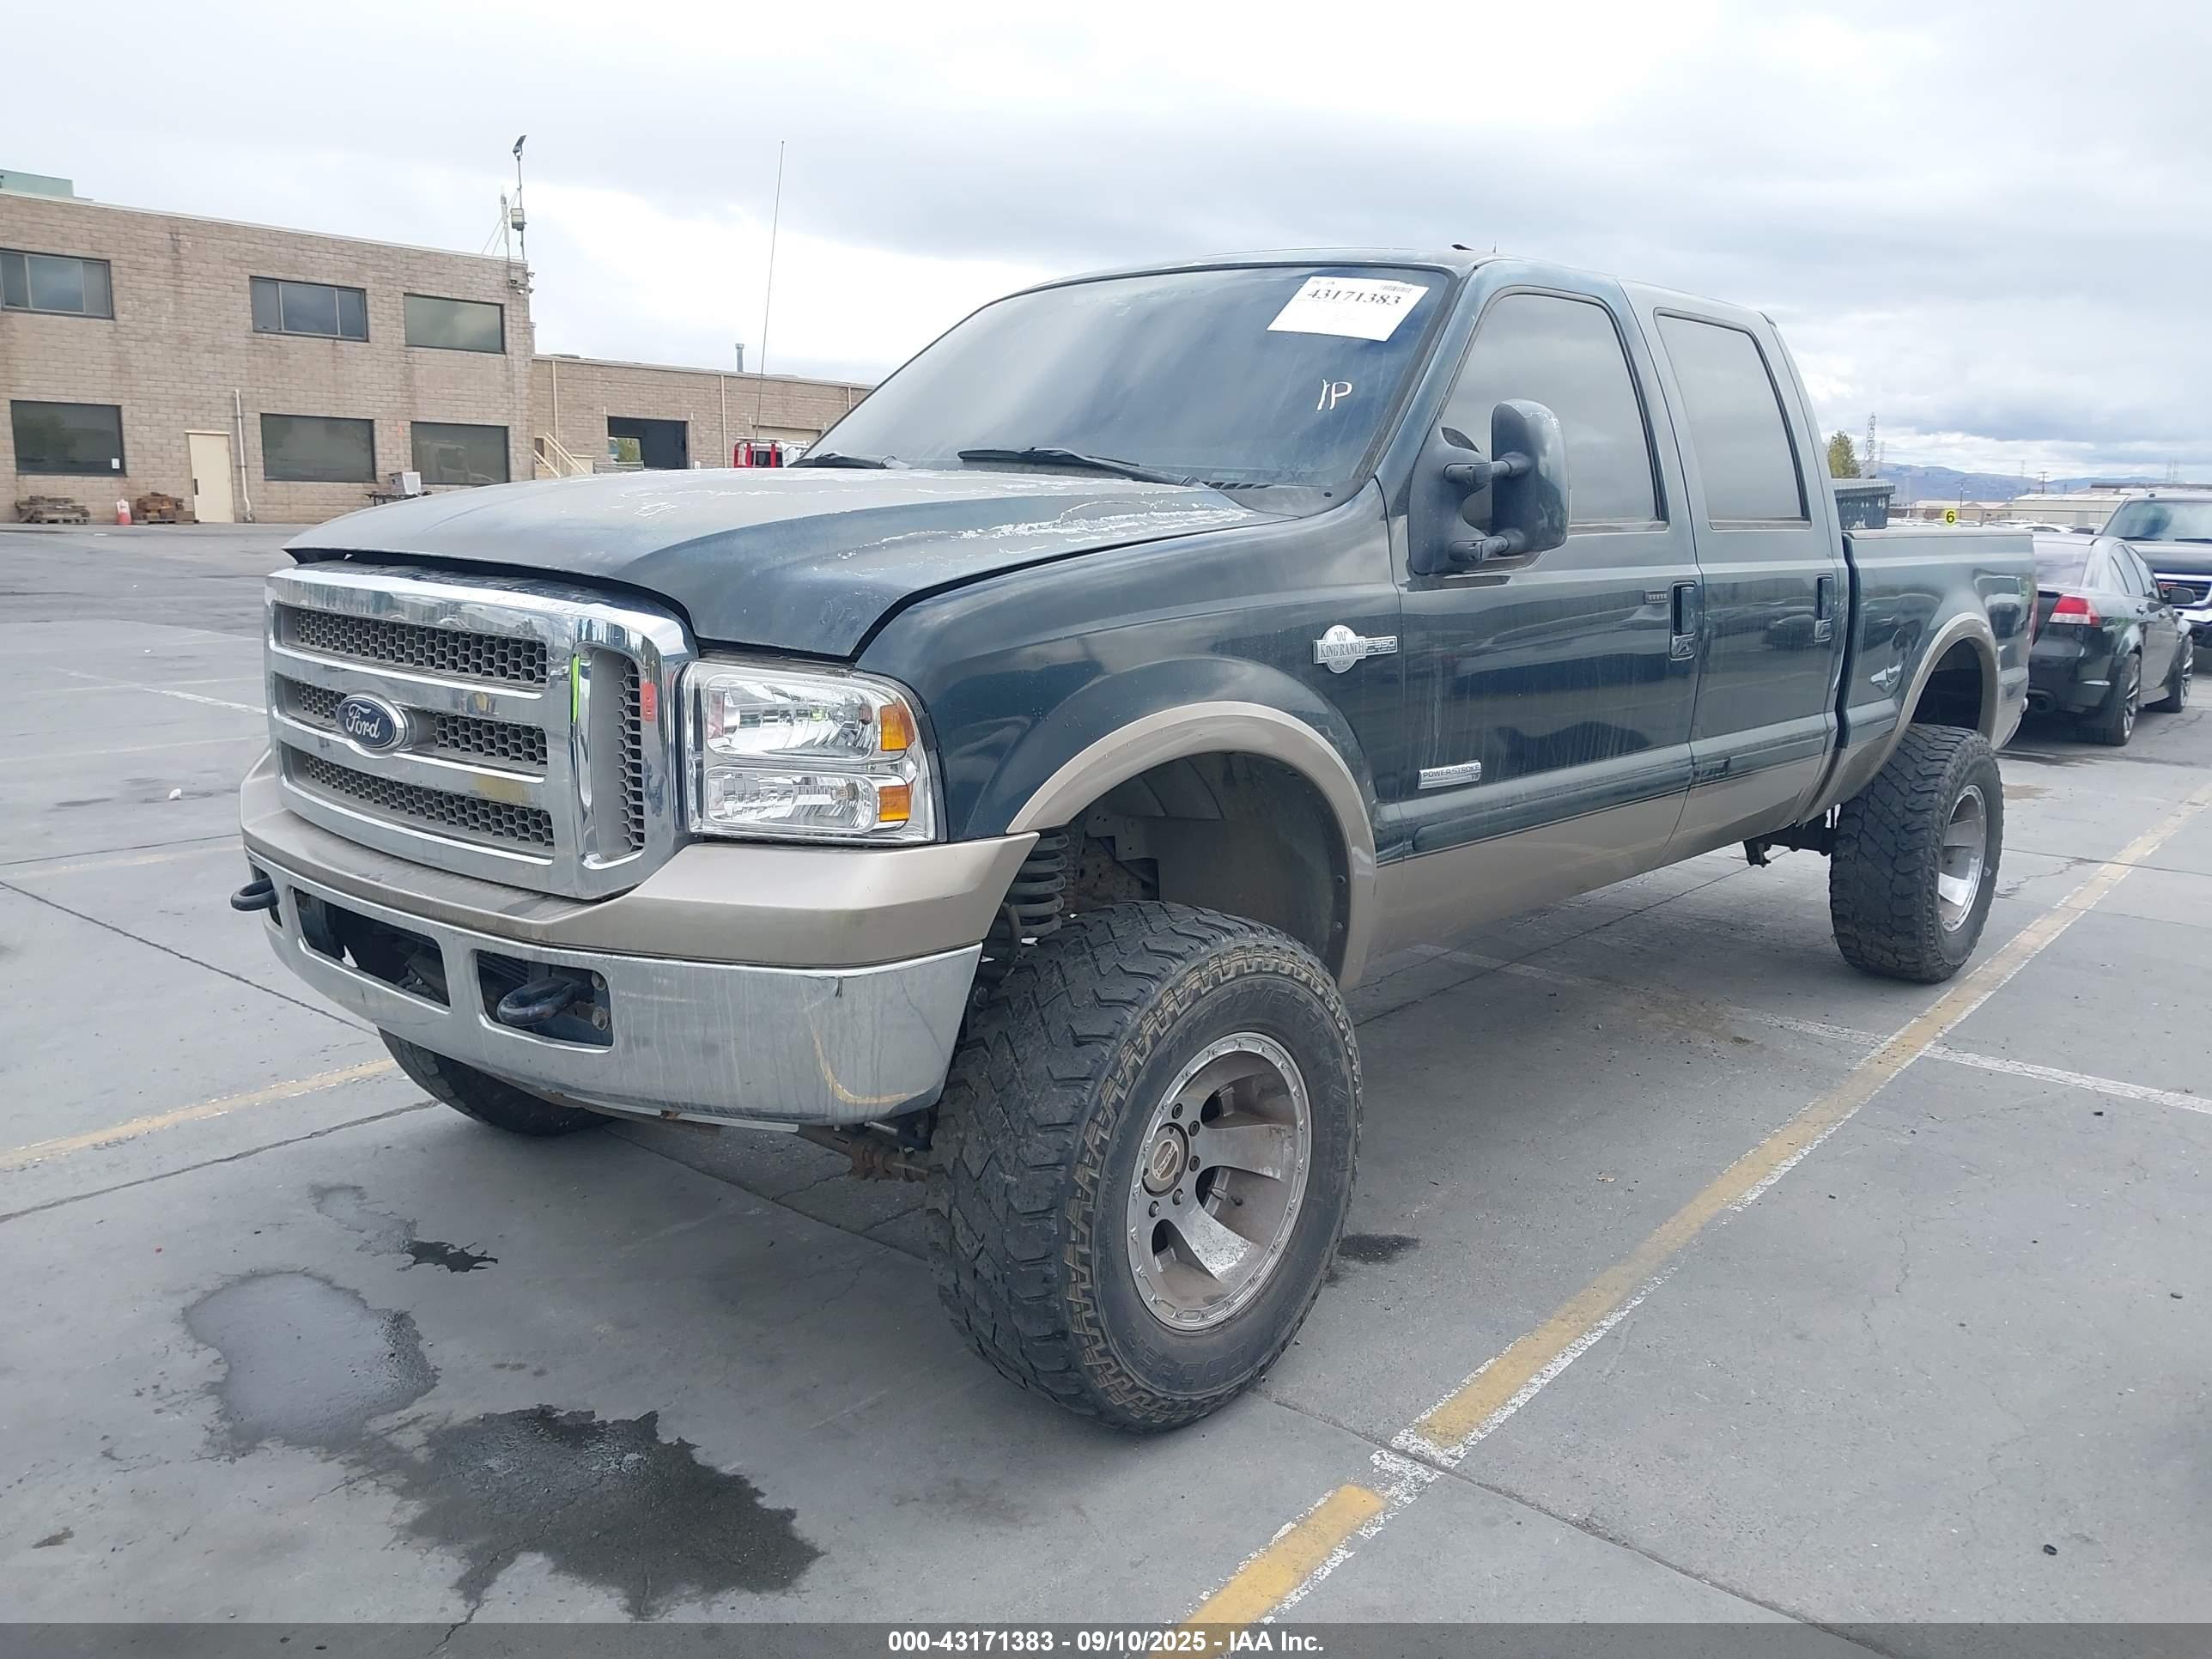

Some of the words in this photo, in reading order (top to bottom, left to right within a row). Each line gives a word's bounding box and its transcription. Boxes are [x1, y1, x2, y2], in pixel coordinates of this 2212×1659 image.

[1307, 289, 1401, 306] 43171383
[1946, 510, 1955, 524] 6
[1320, 642, 1339, 658] KING
[1339, 640, 1364, 657] RANCH
[345, 703, 380, 738] Ford
